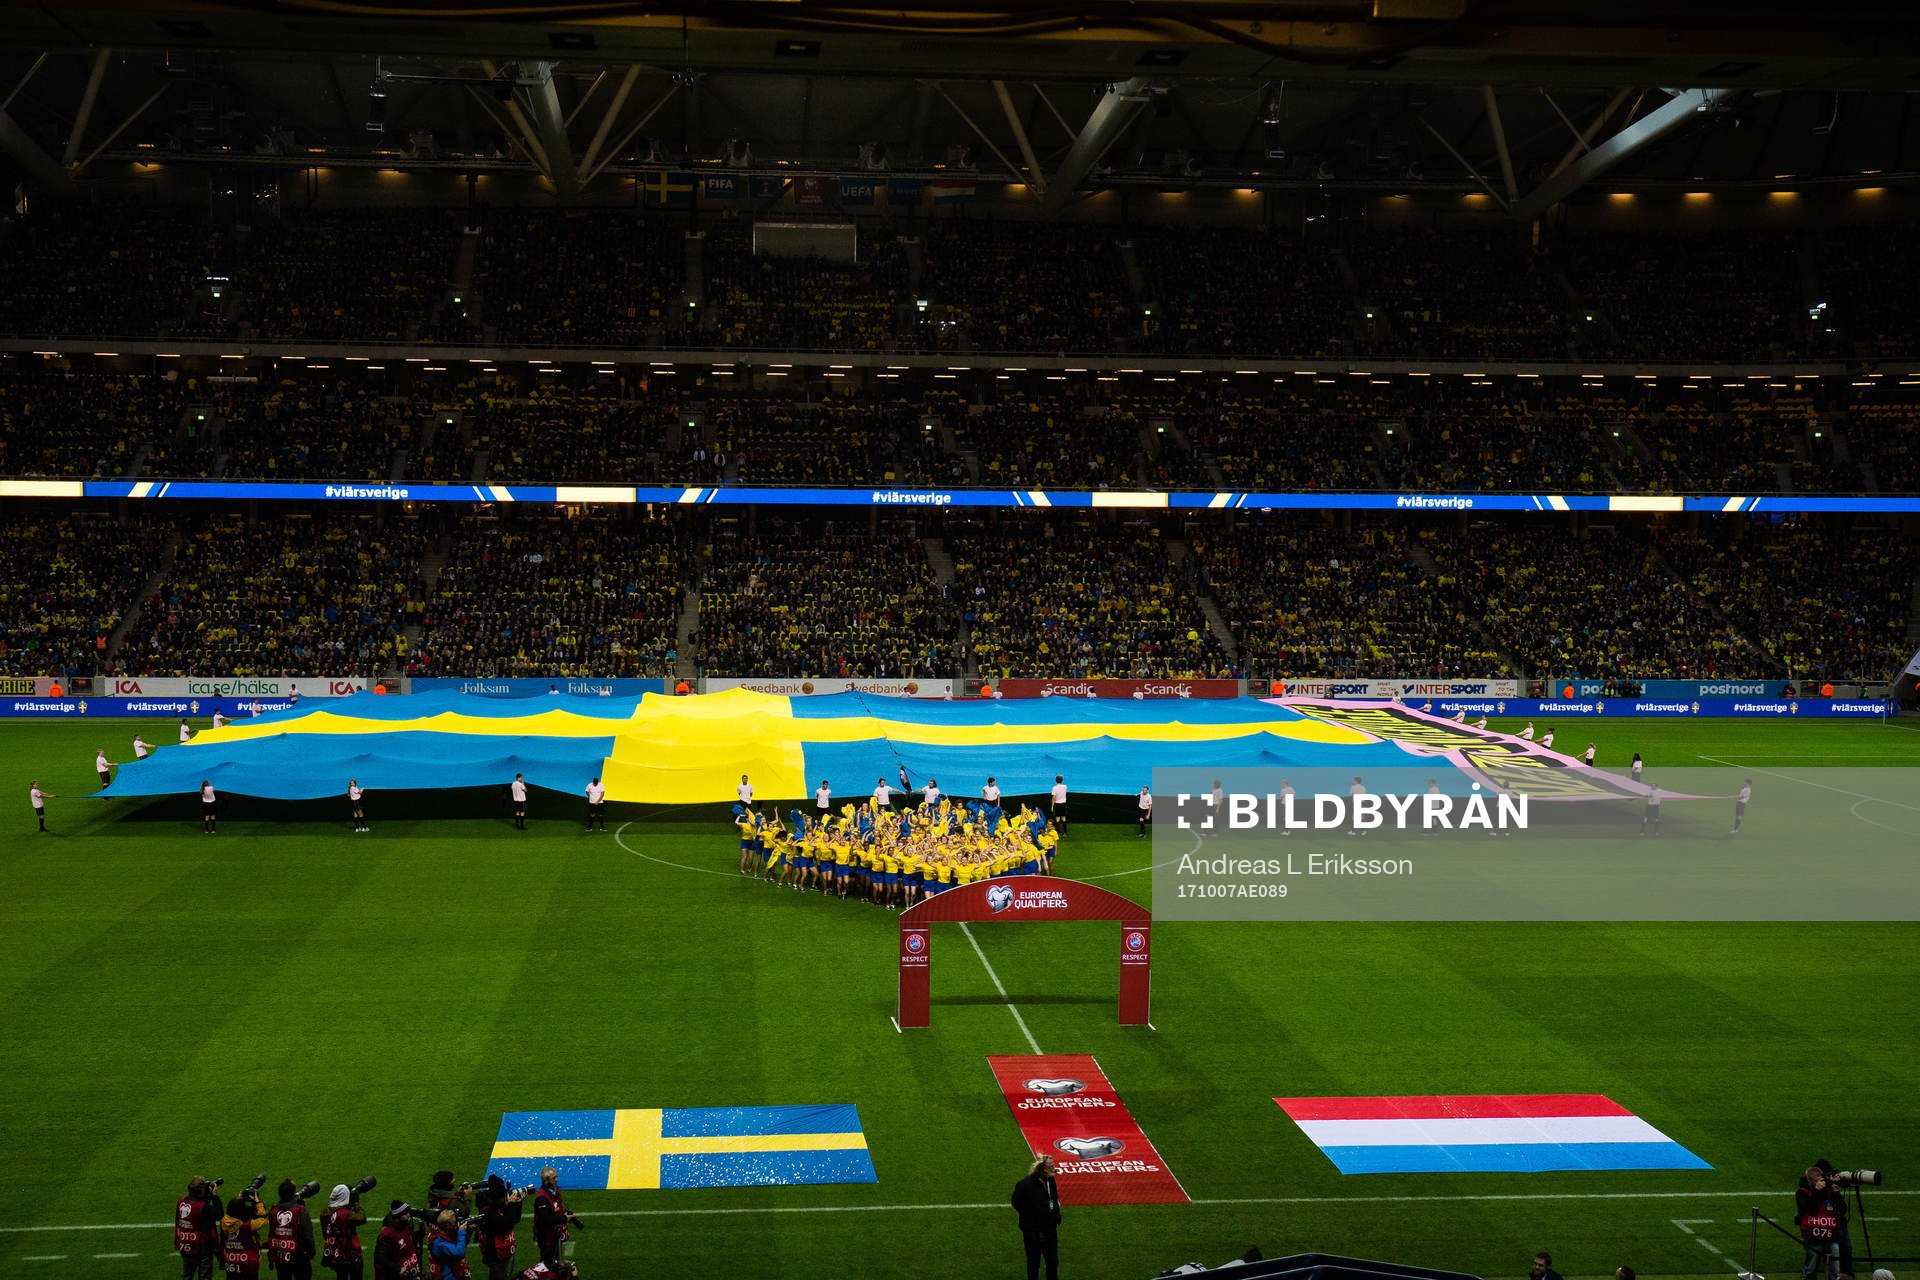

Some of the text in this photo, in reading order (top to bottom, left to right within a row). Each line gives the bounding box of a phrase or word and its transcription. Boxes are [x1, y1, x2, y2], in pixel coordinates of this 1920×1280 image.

[709, 178, 734, 190] FIFA
[841, 184, 872, 197] UEFA
[325, 486, 409, 500] #viärsverige
[872, 491, 951, 505] #viärsverige
[1397, 496, 1473, 509] #viärsverige
[0, 680, 34, 693] RIGE
[115, 681, 142, 694] ICA
[188, 680, 279, 695] ica.se/hälsa
[329, 681, 355, 694] ICA
[463, 682, 510, 693] Folksam
[1416, 684, 1487, 694] INTERSPORT
[1700, 684, 1764, 696] postnord
[14, 703, 75, 712] #viärsverige
[127, 703, 187, 712] #viärsverige
[1539, 704, 1593, 712] #viärsverige
[1635, 704, 1689, 712] #viärsverige
[1734, 703, 1787, 712] #viärsverige
[1831, 703, 1884, 712] #viärsverige
[1020, 891, 1062, 900] EUROPEAN
[1014, 899, 1067, 909] QUALIFIERS
[1018, 1101, 1116, 1109] QUALIFIERS
[1025, 1097, 1103, 1105] EUROPEAN
[1058, 1160, 1145, 1168] EUROPEAN
[1807, 1216, 1837, 1227] PHOTO
[1812, 1227, 1833, 1238] 076
